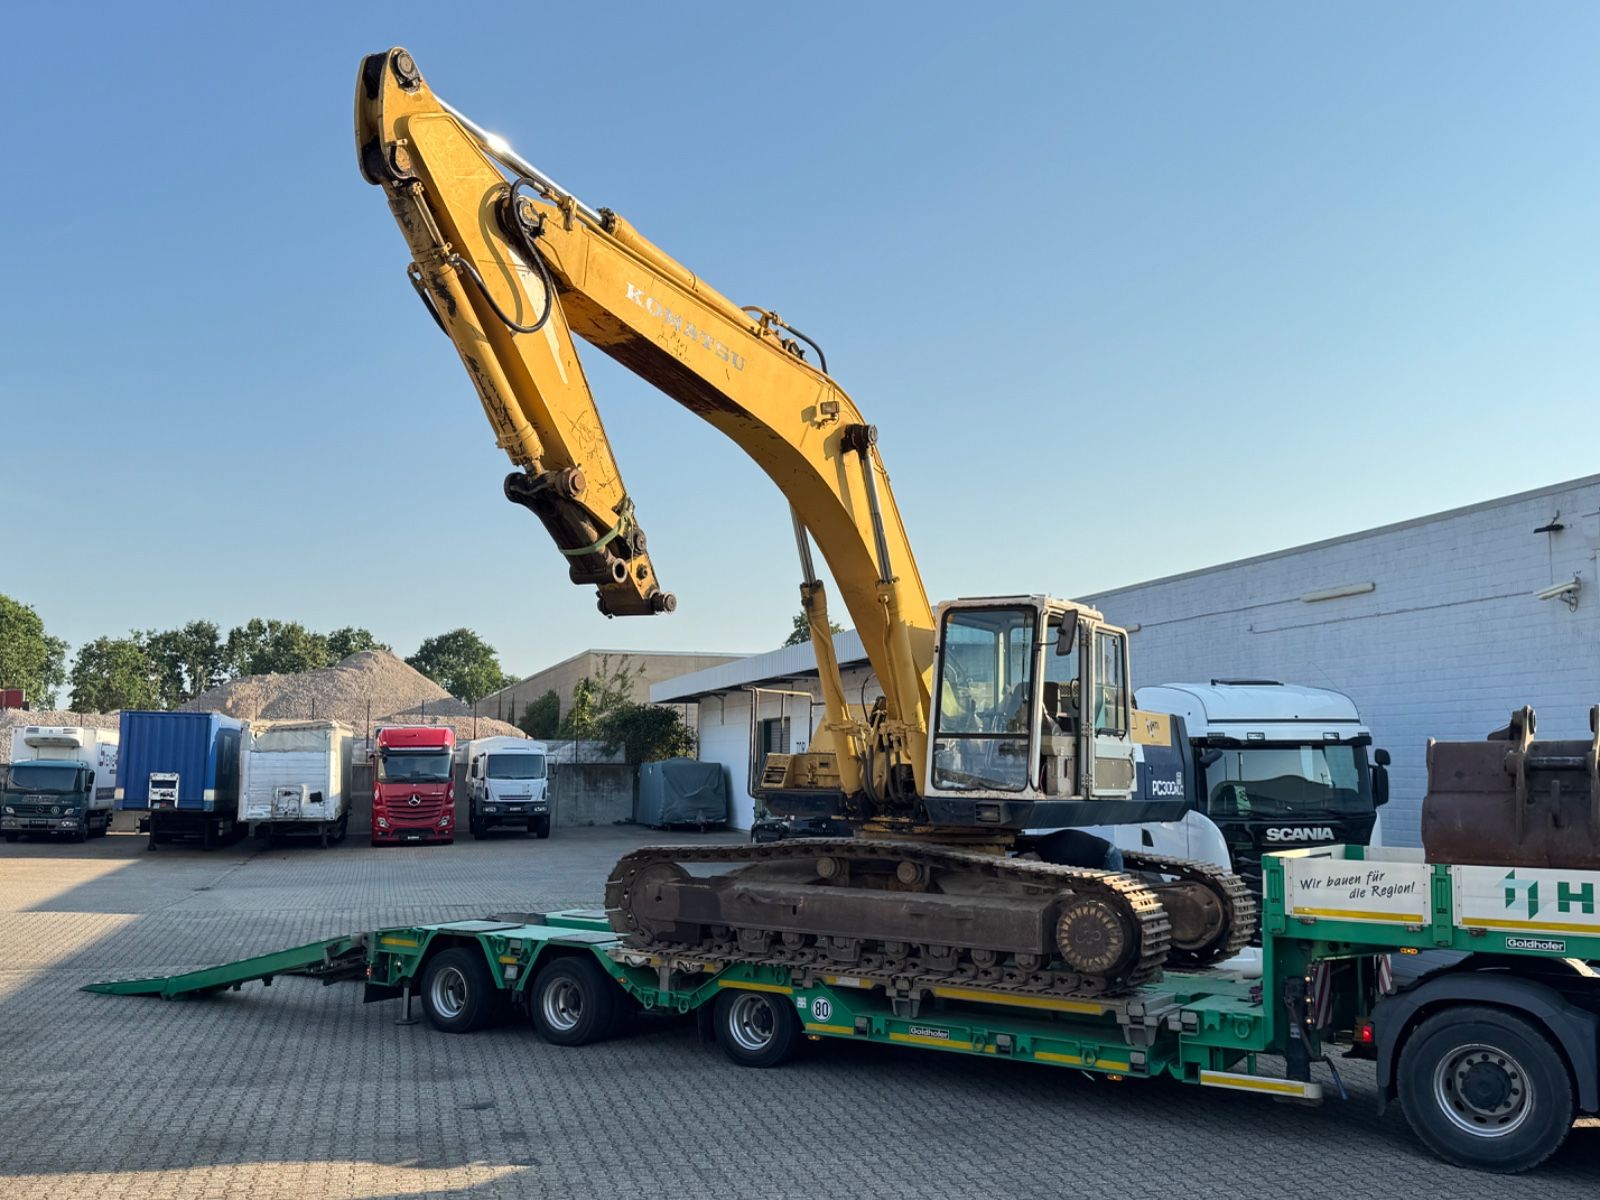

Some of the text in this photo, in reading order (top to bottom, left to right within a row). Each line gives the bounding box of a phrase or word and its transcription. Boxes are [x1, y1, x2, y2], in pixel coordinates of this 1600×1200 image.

[625, 281, 746, 372] KOMATSU
[1266, 827, 1335, 841] SCANIA
[1300, 869, 1385, 890] Wir bauen für
[1349, 881, 1415, 899] die Region!
[1507, 939, 1564, 950] Goldhofer
[815, 1001, 828, 1017] 80
[910, 1027, 948, 1039] Goldhofer
